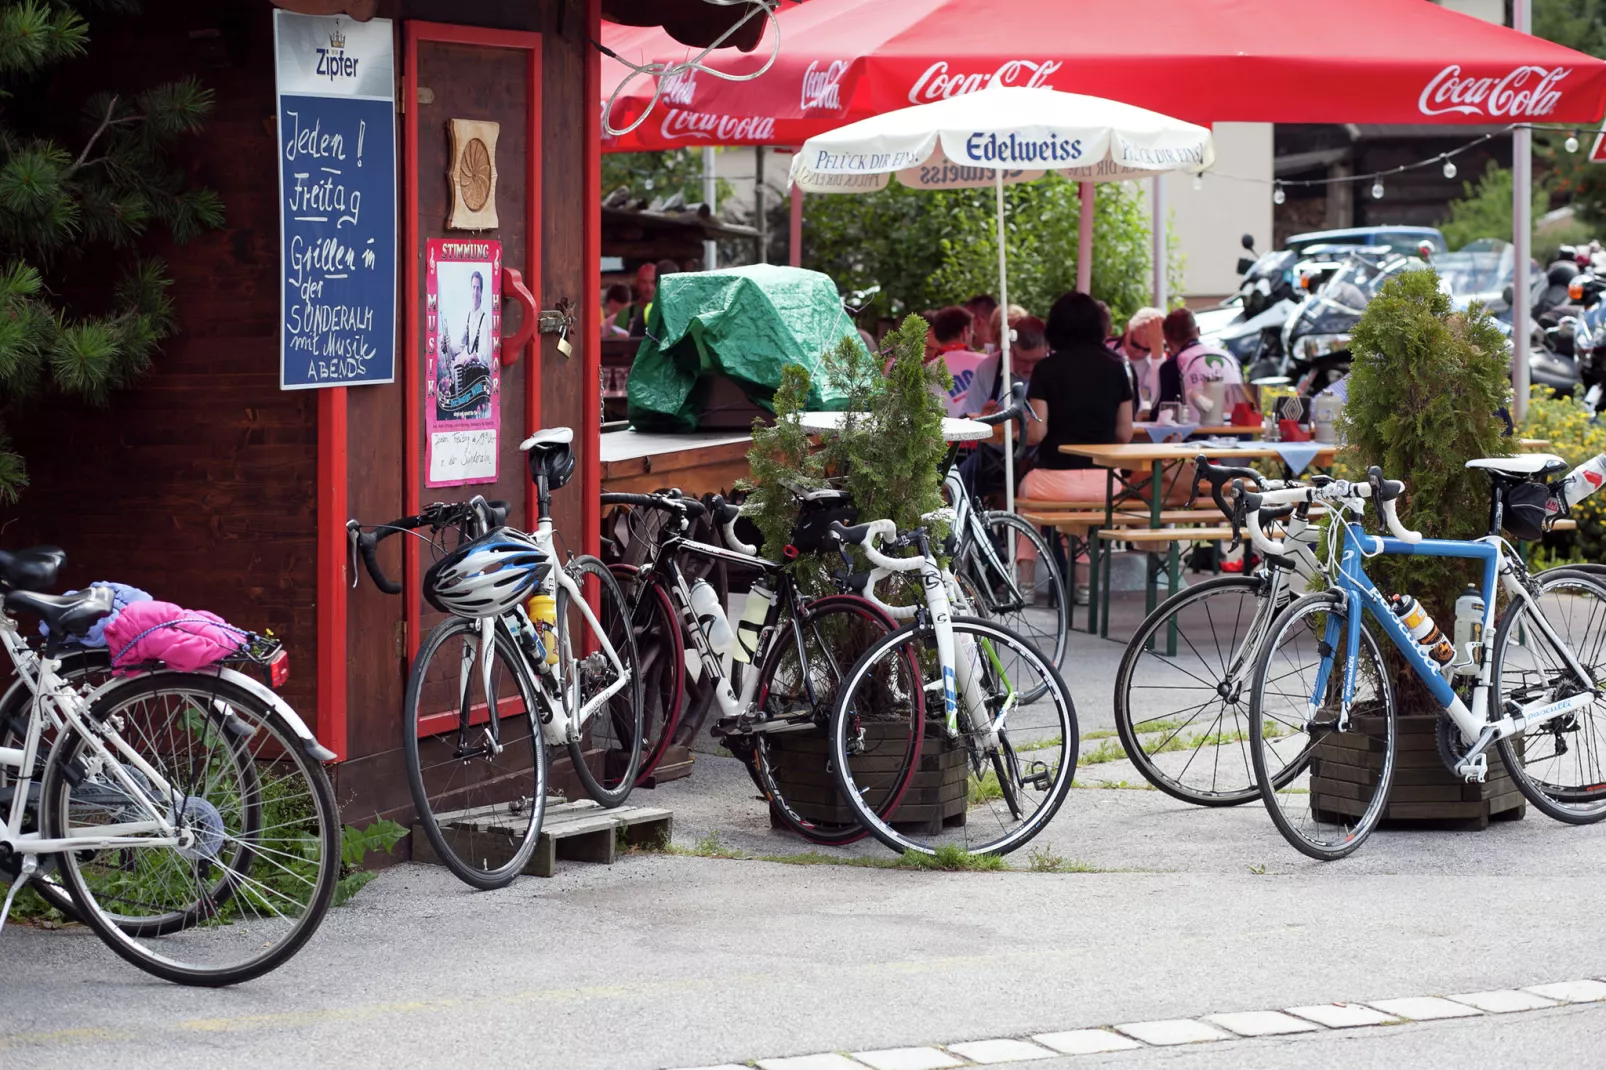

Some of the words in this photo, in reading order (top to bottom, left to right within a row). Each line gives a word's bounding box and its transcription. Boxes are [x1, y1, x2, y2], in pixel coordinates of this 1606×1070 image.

[316, 48, 359, 81] Zipfer
[1418, 65, 1573, 117] Coca-Cola
[286, 110, 346, 161] Jeden
[966, 132, 1082, 162] Edelweiss
[869, 153, 891, 169] DIR
[289, 173, 361, 228] Freitag
[289, 235, 356, 287] Grillen
[442, 243, 489, 259] STIMMUNG
[300, 276, 324, 303] der
[290, 333, 319, 355] mit
[322, 332, 376, 360] Musik
[307, 359, 367, 381] ABENDS
[1527, 699, 1573, 720] pasculli
